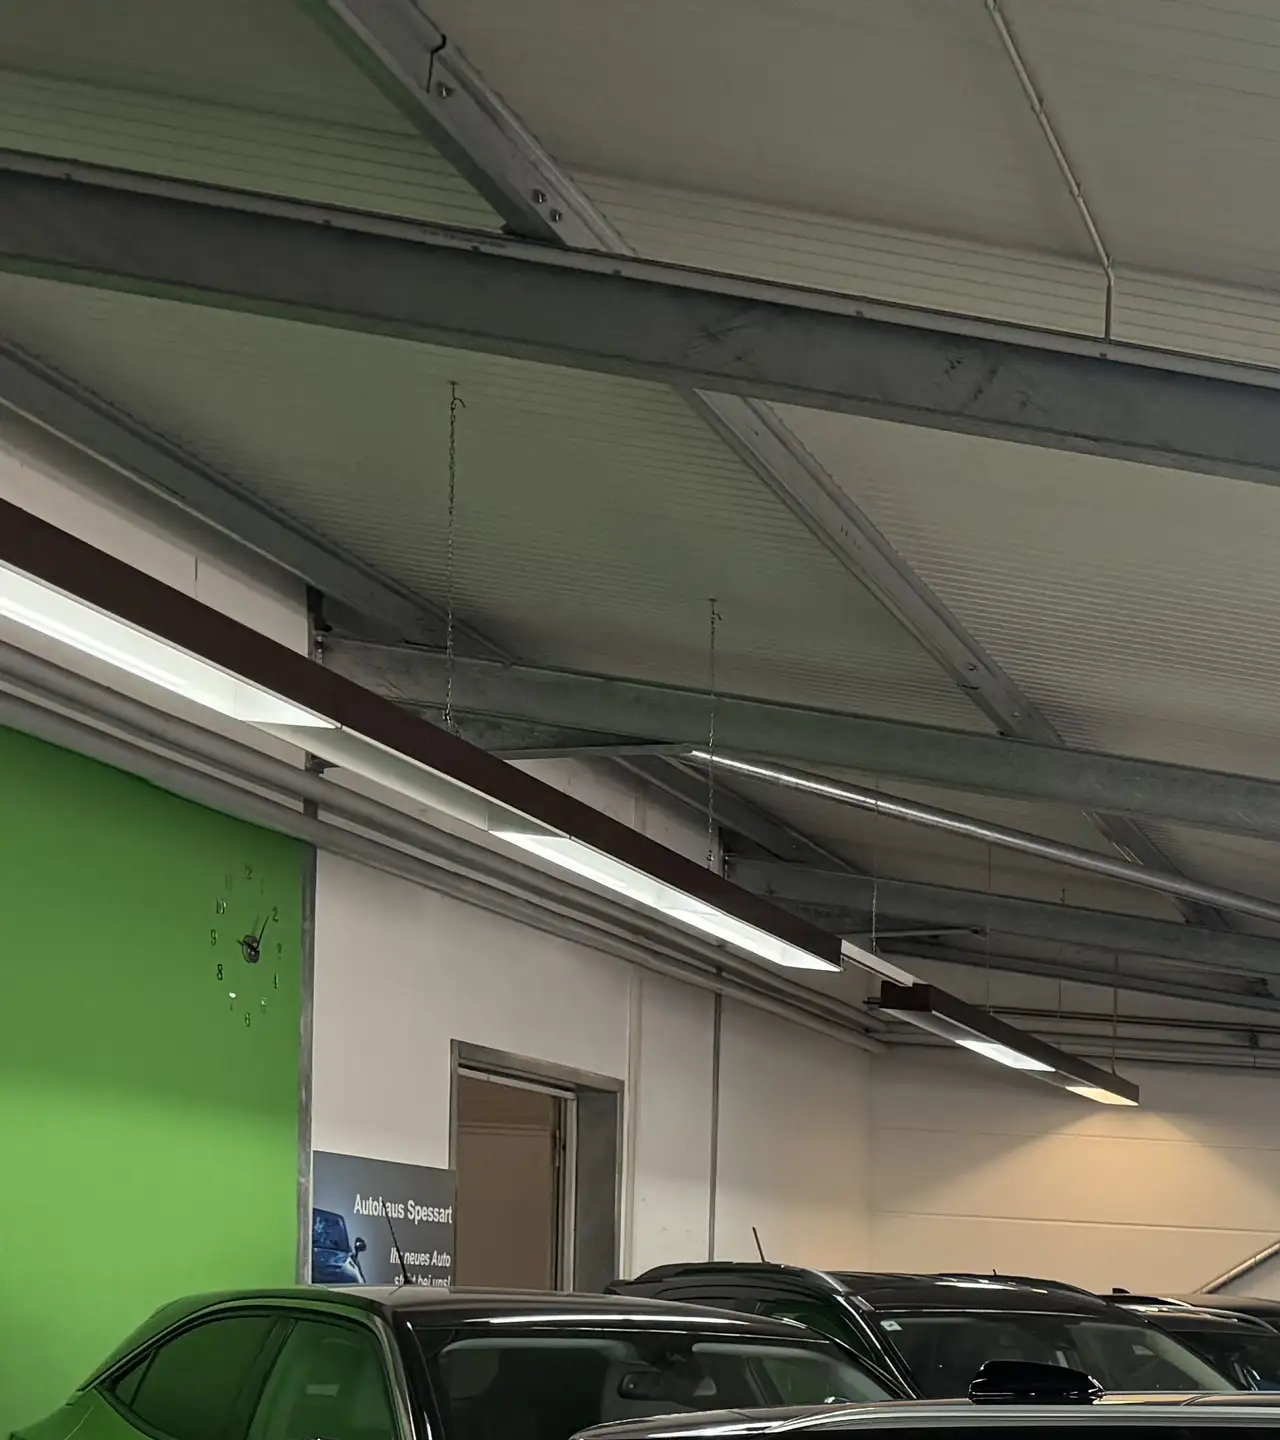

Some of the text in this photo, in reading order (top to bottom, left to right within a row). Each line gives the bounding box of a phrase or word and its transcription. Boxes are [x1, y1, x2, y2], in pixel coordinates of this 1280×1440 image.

[216, 963, 223, 981] 8
[353, 1193, 453, 1225] Autohaus Spessart
[390, 1247, 451, 1268] Ih neues Auto
